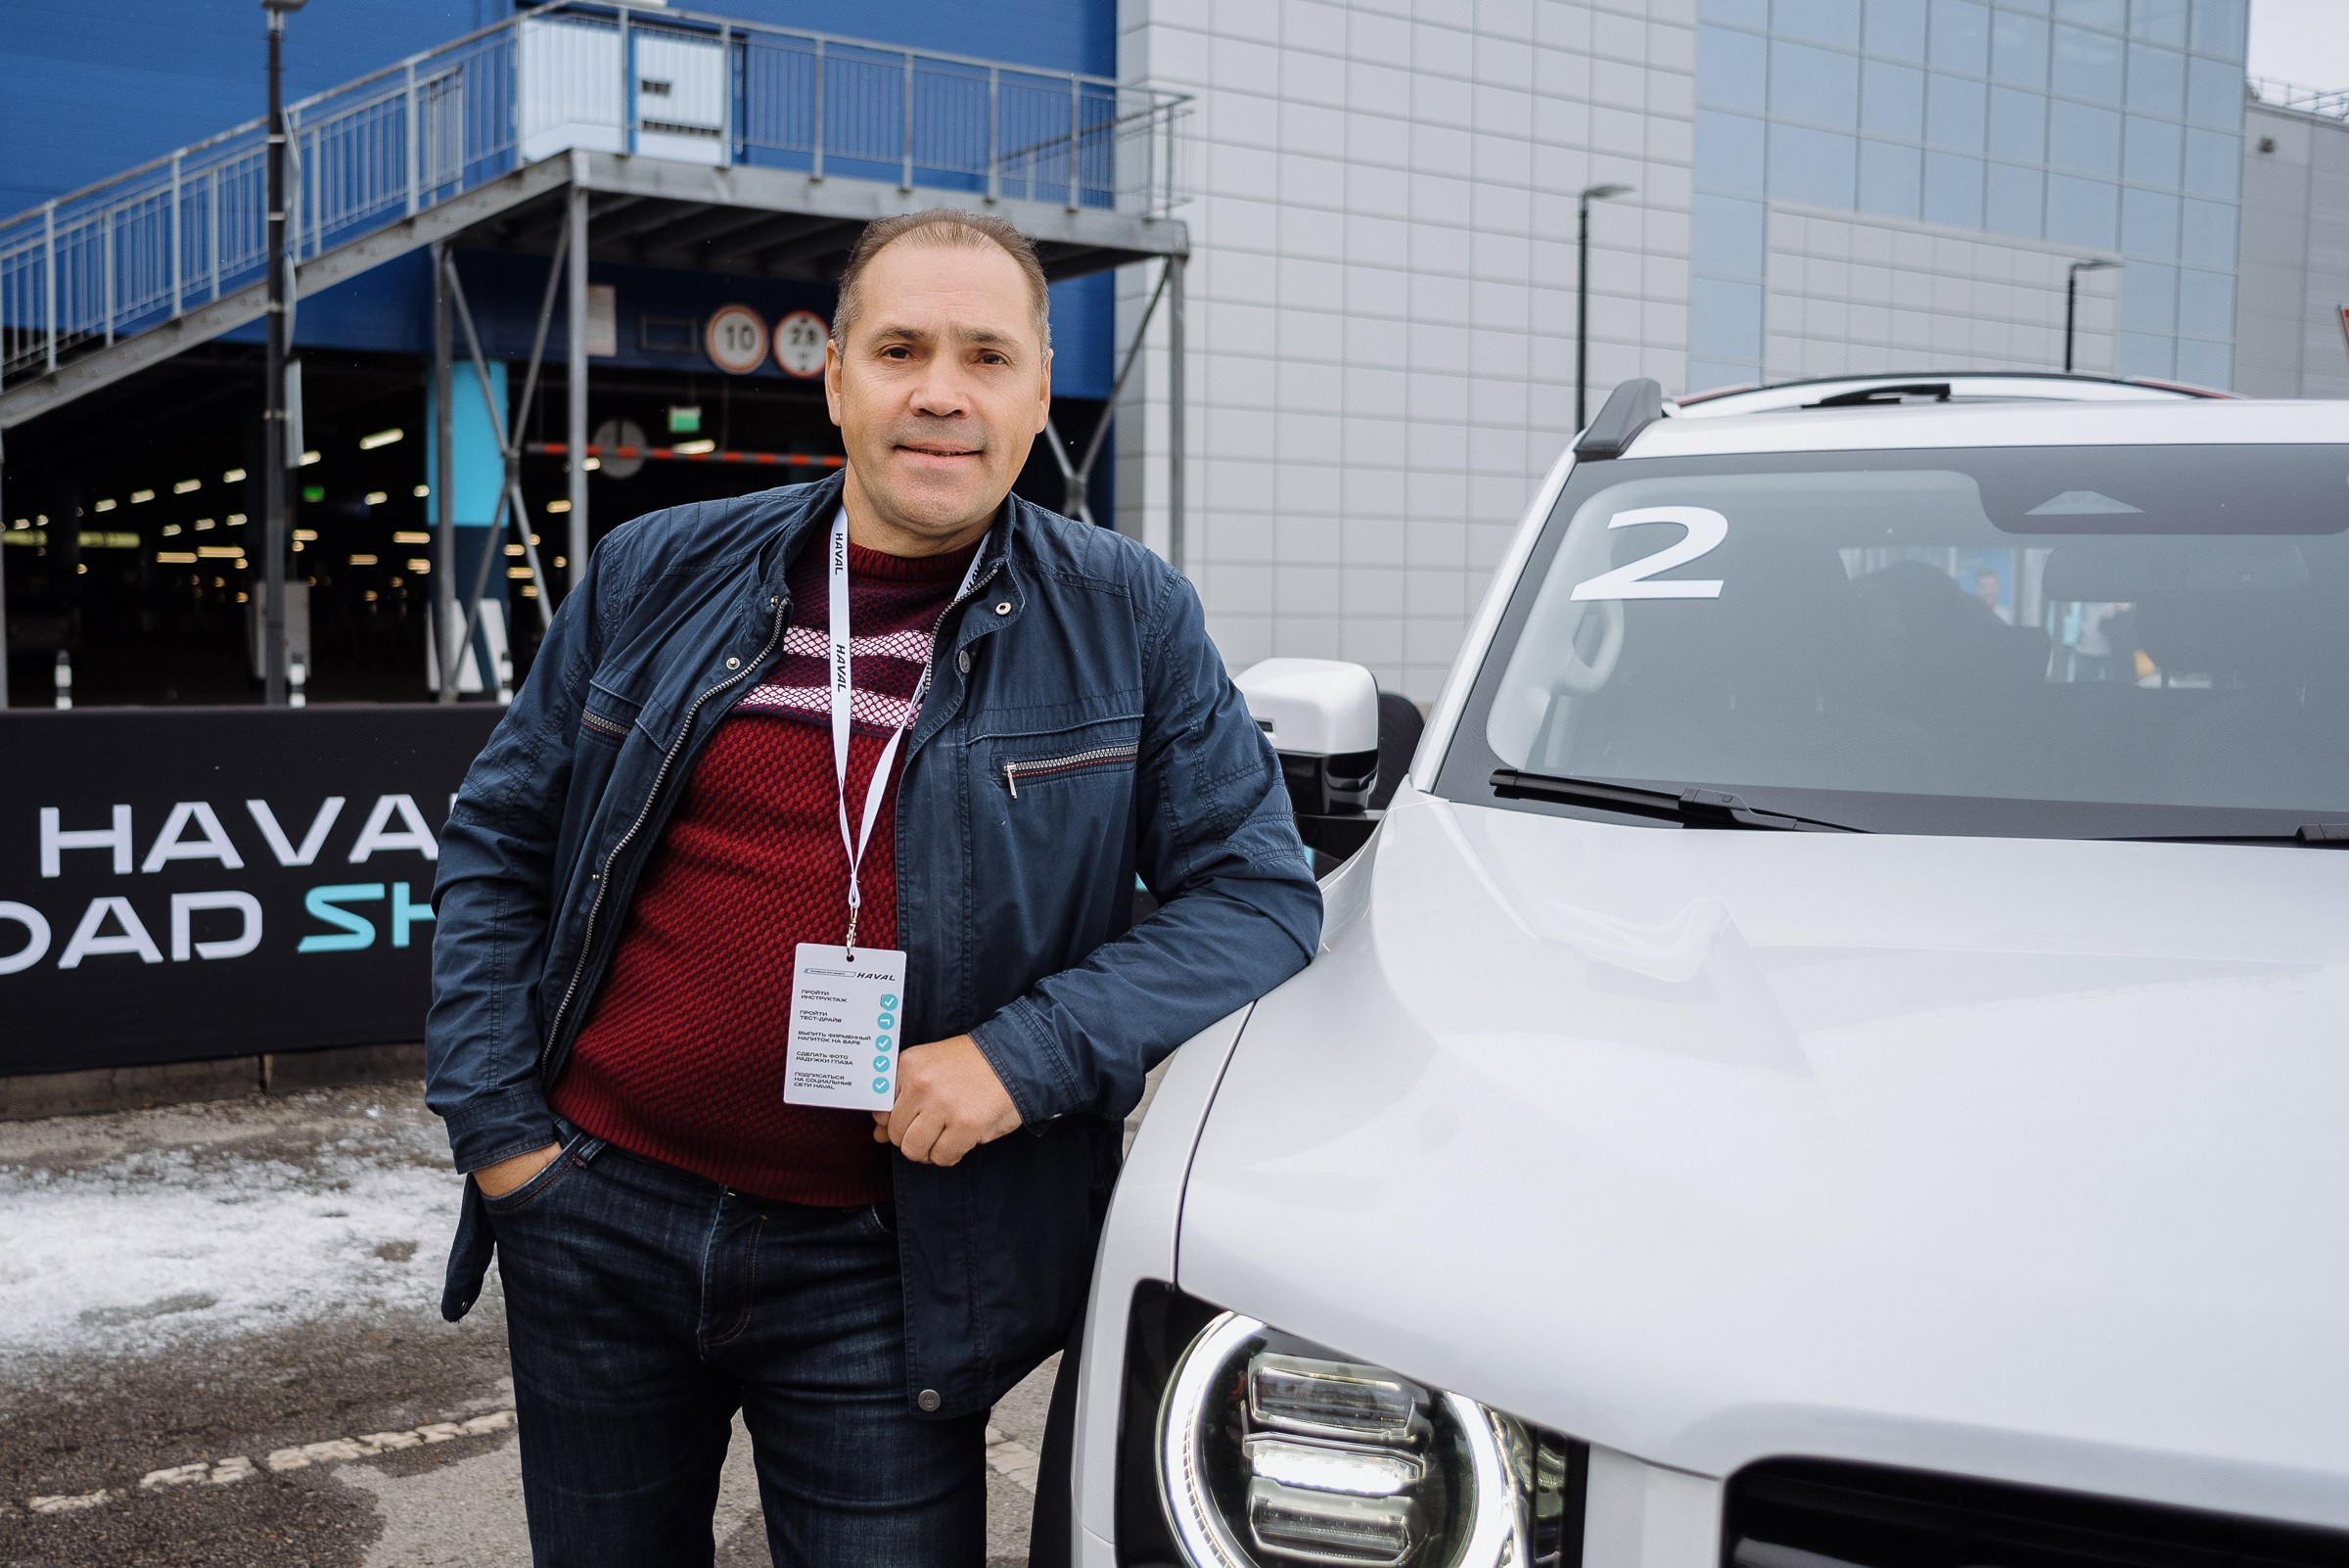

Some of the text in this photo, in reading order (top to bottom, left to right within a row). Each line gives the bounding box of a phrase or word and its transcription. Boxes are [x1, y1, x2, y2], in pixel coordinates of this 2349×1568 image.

[725, 325, 756, 351] 10
[835, 532, 844, 576] HAVAL
[1570, 505, 1728, 601] 2
[836, 643, 847, 693] HAVAL
[40, 792, 459, 878] HAVA
[856, 972, 896, 982] HAVAL
[801, 994, 848, 1003] ИНСТРУКТАЖ
[828, 1033, 871, 1041] ФИРМЕННЫЙ
[794, 1071, 845, 1081] ПОДПИСАТЬСЯ
[806, 1078, 852, 1086] СОЦИАЛЬНЫЕ
